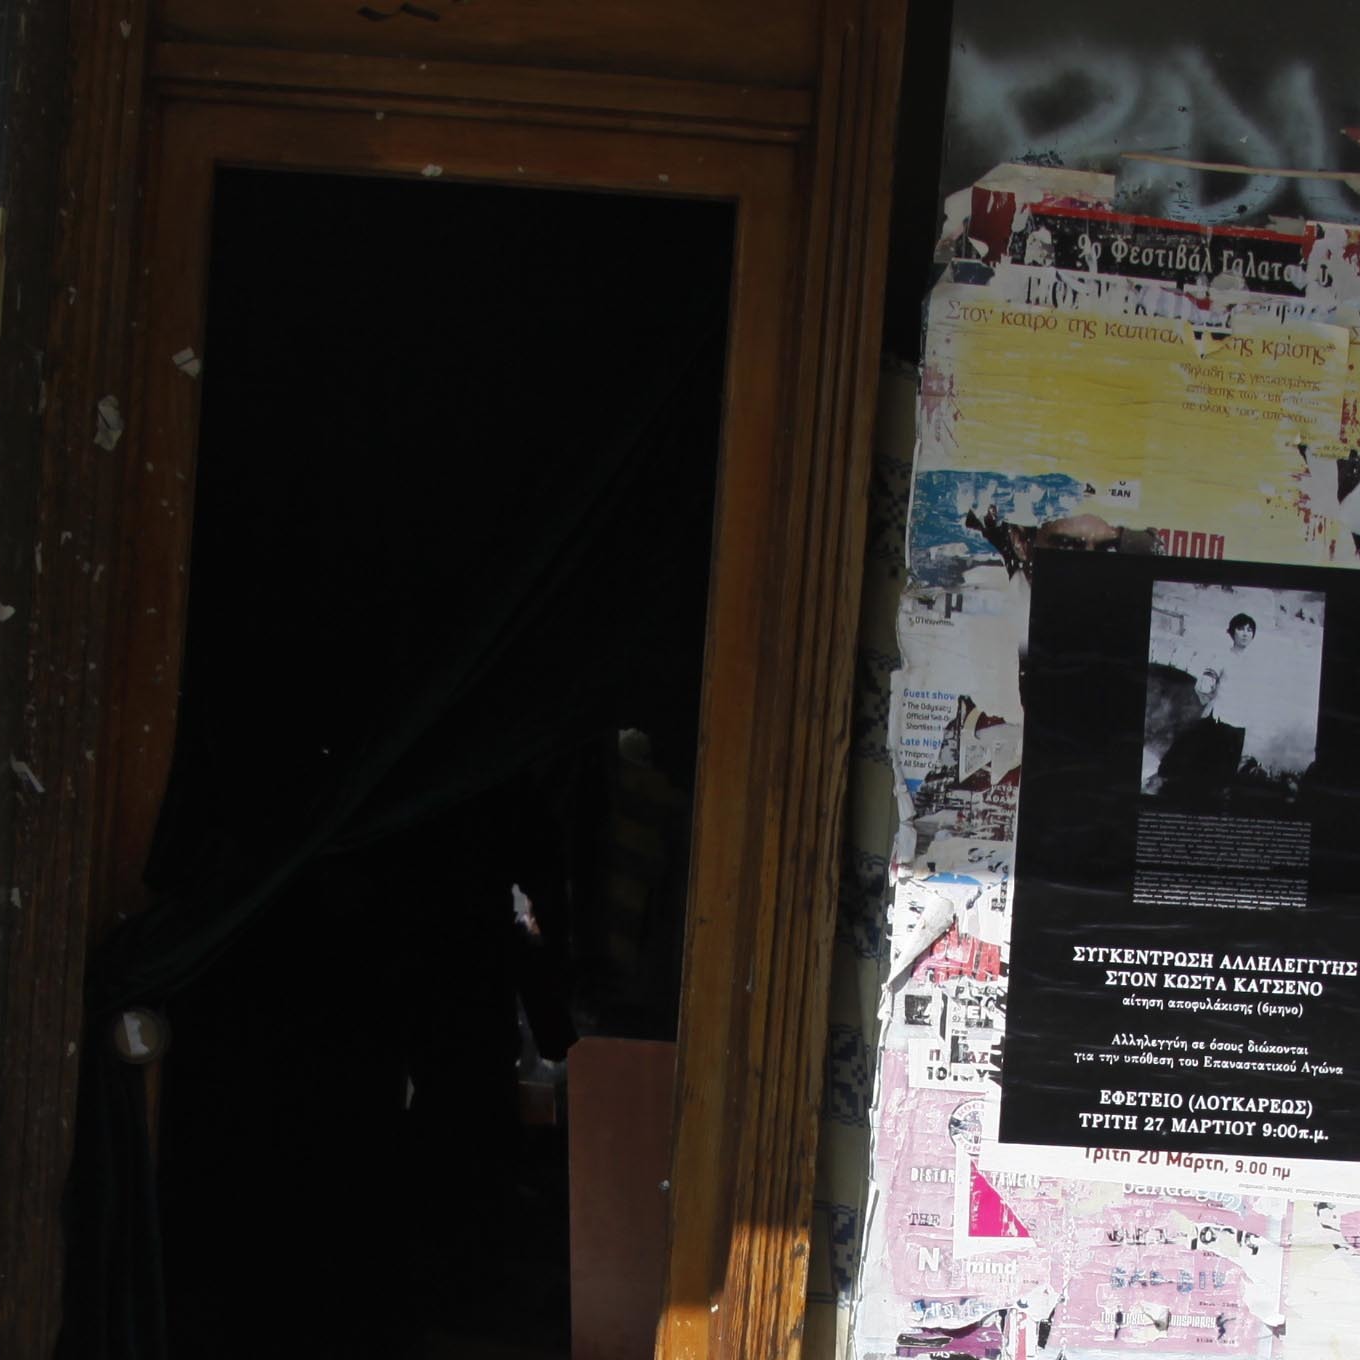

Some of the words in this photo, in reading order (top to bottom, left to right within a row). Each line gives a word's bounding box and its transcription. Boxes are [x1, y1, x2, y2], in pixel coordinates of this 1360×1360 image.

[1110, 241, 1214, 275] Φεστιβάλ
[945, 300, 994, 325] Στον
[1000, 308, 1059, 334] καιρό
[1066, 316, 1098, 340] της
[903, 687, 930, 700] Guest
[1072, 945, 1215, 969] ΣΥΓΚΕΝΤΡΩΣΗ
[1219, 954, 1359, 977] ΑΛΛΗΛΕΓΓΥΗΣ
[1104, 969, 1160, 989] ΣΤΟΝ
[1163, 972, 1228, 992] ΚΩΣΤΑ
[1233, 976, 1324, 997] ΚΑΤΣΕΝΟ
[1122, 993, 1165, 1012] αίτηση
[1167, 998, 1254, 1017] αποφυλάκισης
[1256, 1001, 1305, 1018] (6μηνο)
[1111, 1033, 1189, 1052] Αλληλεγγύη
[1190, 1041, 1207, 1051] σε
[1208, 1039, 1245, 1055] όσους
[1246, 1039, 1309, 1057] διώκονται
[1073, 1050, 1095, 1064] για
[1097, 1052, 1121, 1065] την
[1123, 1052, 1175, 1071] υπόθεση
[1177, 1056, 1200, 1068] του
[1203, 1056, 1298, 1075] Επαναστατικού
[1300, 1061, 1345, 1077] Αγώνα
[1098, 1089, 1184, 1110] ΕΦΕΤΕΙΟ
[1187, 1092, 1315, 1119] (ΛΟΥΚΑΡΕΩΣ)
[1078, 1111, 1139, 1132] ΤΡΙΤΗ
[1142, 1115, 1165, 1133] 27
[1170, 1118, 1257, 1138] ΜΑΡΤΙΟΥ
[1261, 1123, 1330, 1142] 9:00π.μ.
[1165, 1152, 1230, 1176] Μάρτη,
[1235, 1159, 1269, 1176] 9.00
[1270, 1165, 1292, 1180] πμ
